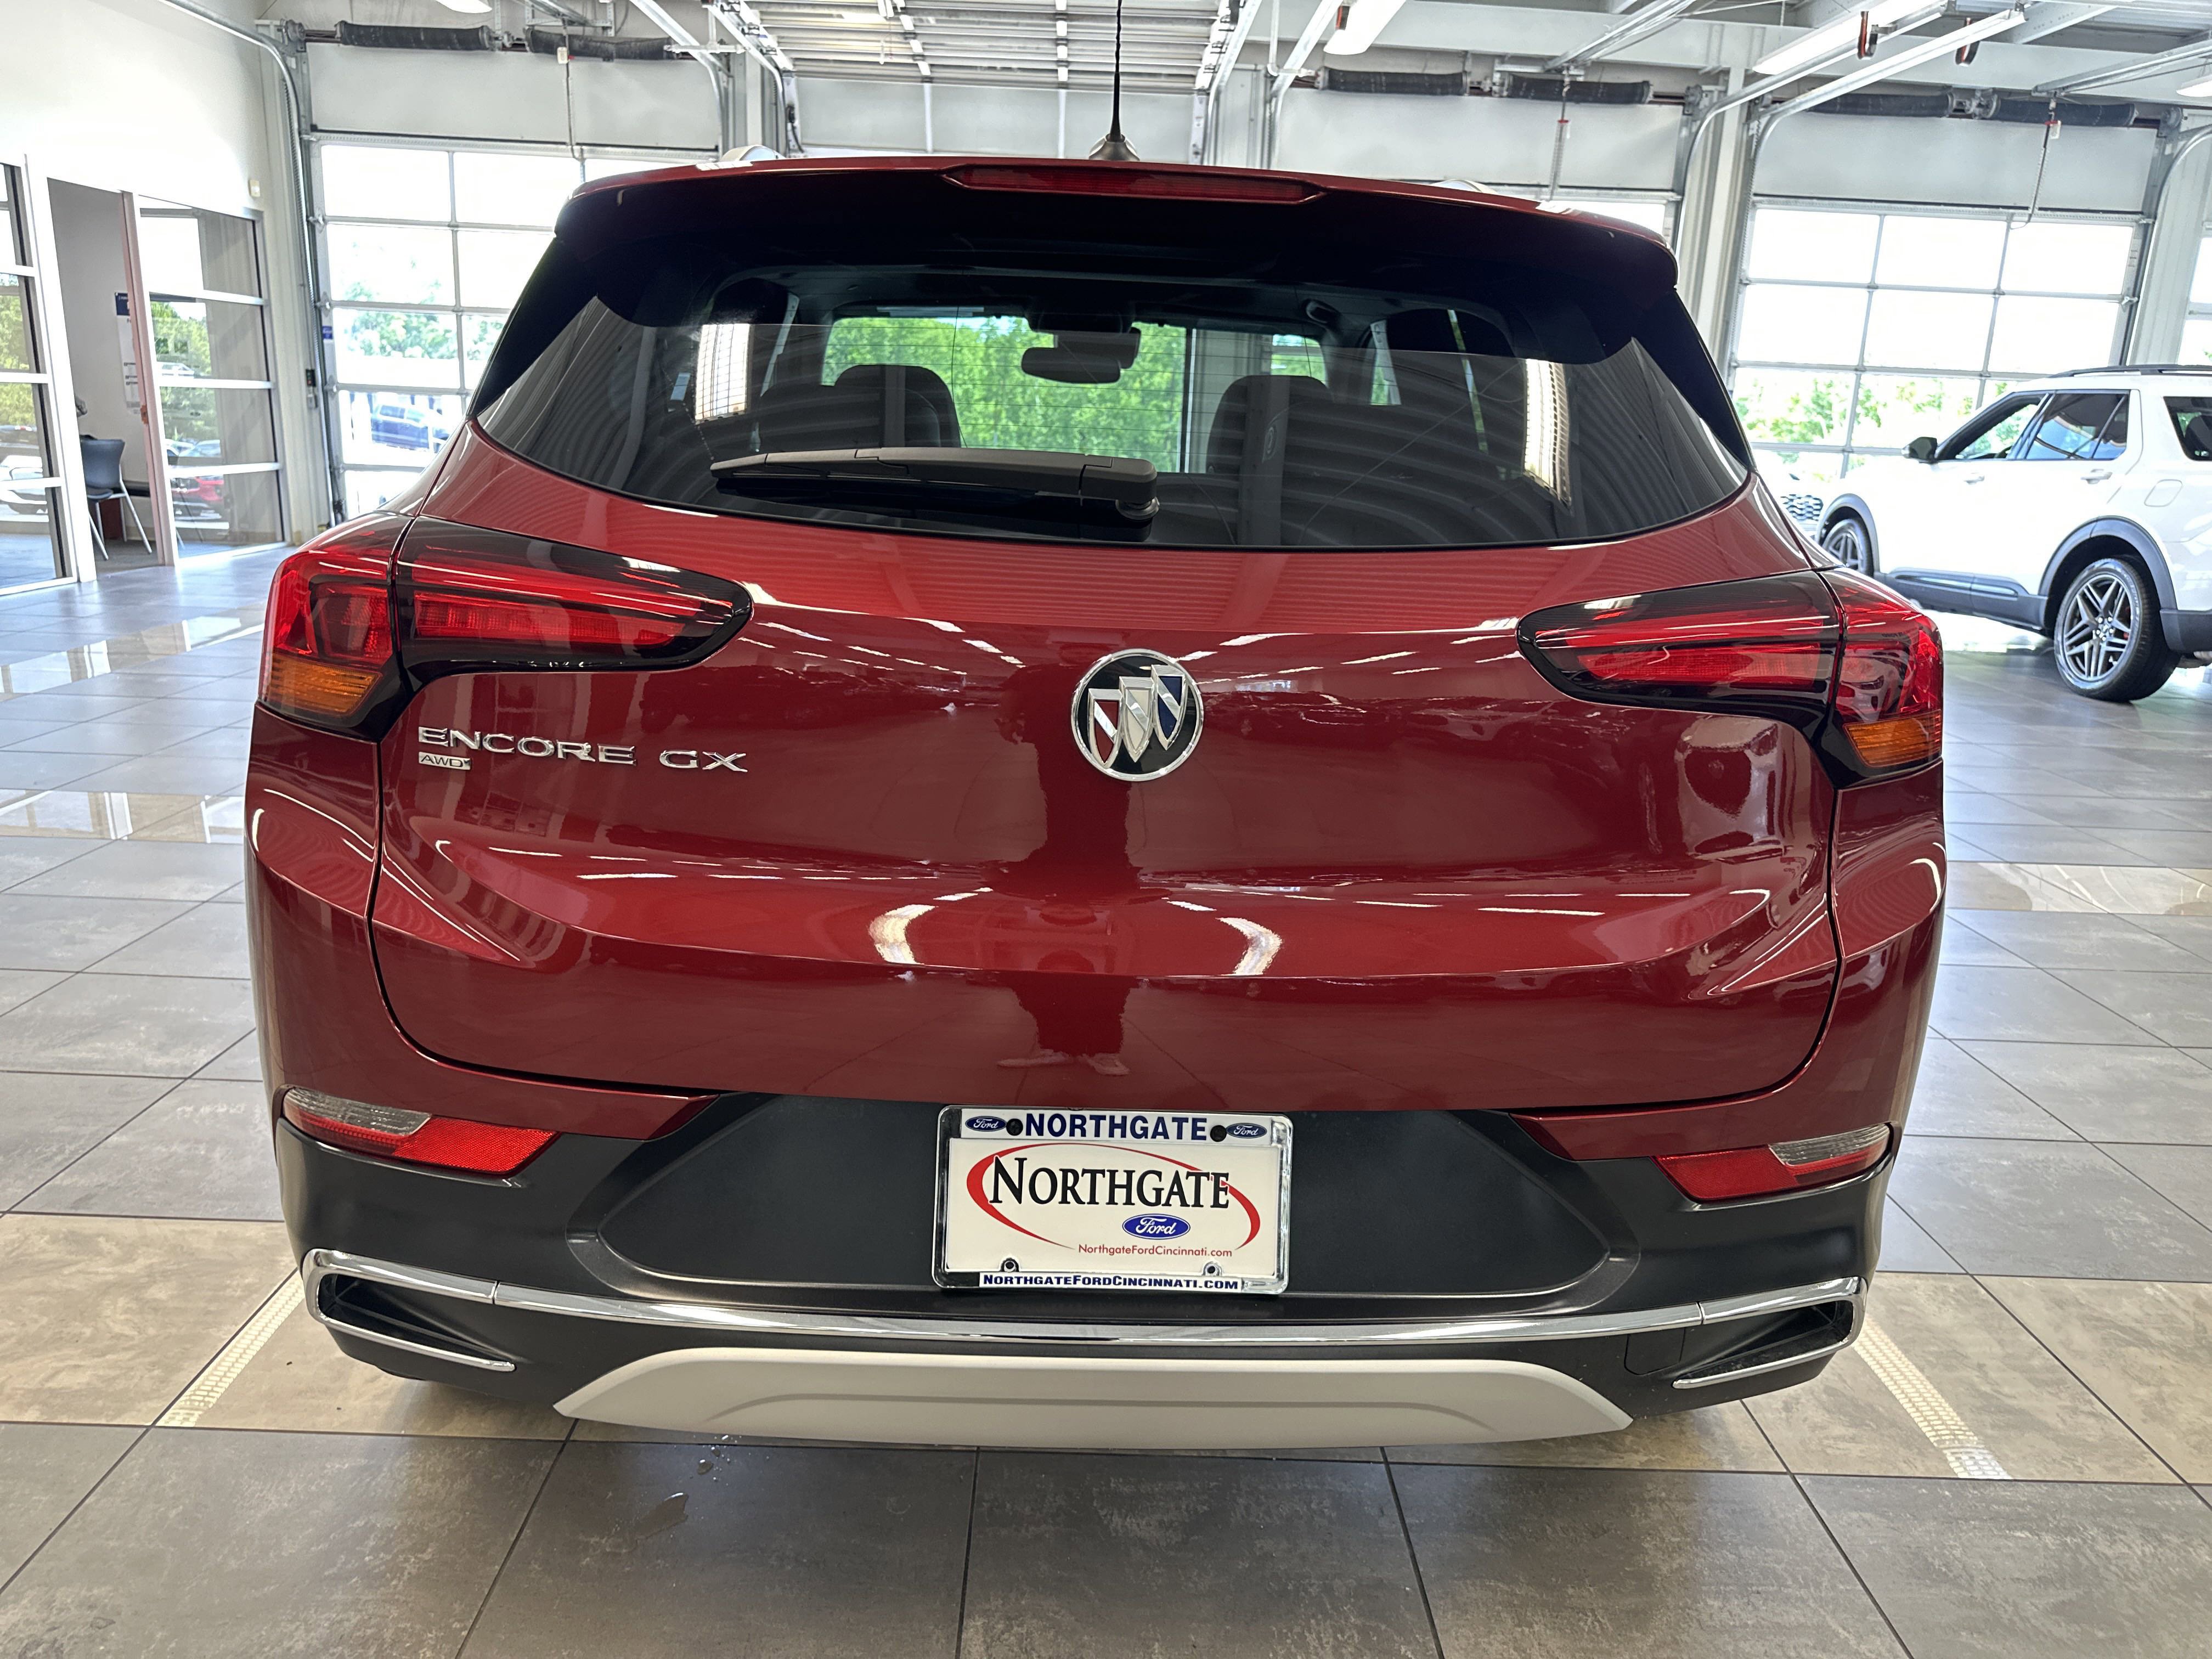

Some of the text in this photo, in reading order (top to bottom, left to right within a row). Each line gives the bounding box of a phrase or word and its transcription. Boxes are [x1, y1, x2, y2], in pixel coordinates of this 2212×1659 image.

[418, 726, 748, 772] ENCORE GX
[421, 755, 463, 768] AWD
[973, 1113, 1259, 1141] Ford NORTHGATE Ford
[988, 1156, 1231, 1209] NORTHGATE
[1136, 1217, 1177, 1234] Ford
[1078, 1244, 1233, 1257] NorthgateFordCincinnati.com
[983, 1274, 1239, 1290] NORTHGATEFORDCINCINNATI.COM
